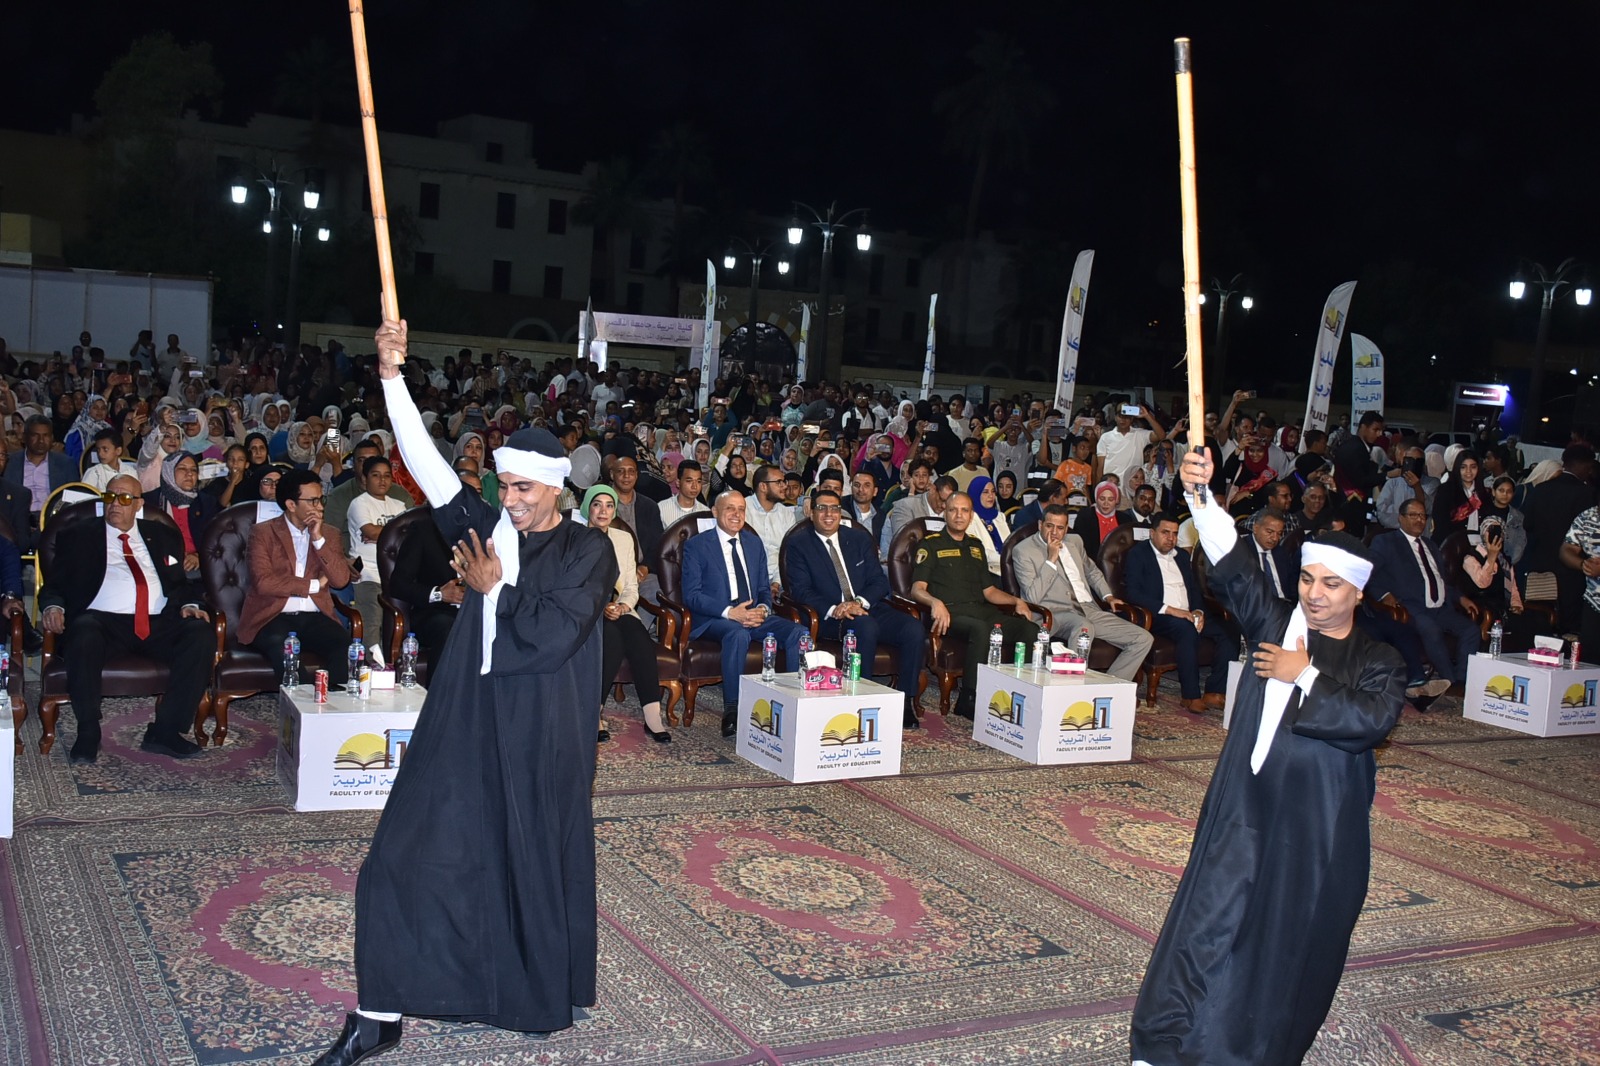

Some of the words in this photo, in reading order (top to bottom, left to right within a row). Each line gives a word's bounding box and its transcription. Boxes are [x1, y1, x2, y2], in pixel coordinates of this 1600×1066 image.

[1354, 377, 1382, 388] كلية
[1354, 392, 1382, 403] التربية
[1483, 699, 1507, 710] التربية
[1508, 705, 1529, 716] كلية
[1505, 714, 1529, 723] EDUCATION
[987, 717, 1006, 732] التربية
[749, 729, 767, 744] التربية
[1007, 726, 1024, 740] كلية
[1088, 733, 1112, 744] كلية
[767, 737, 782, 753] كلية
[1059, 734, 1087, 745] التربية
[820, 749, 852, 761] التربية
[854, 747, 882, 758] كلية
[333, 775, 376, 787] التربية
